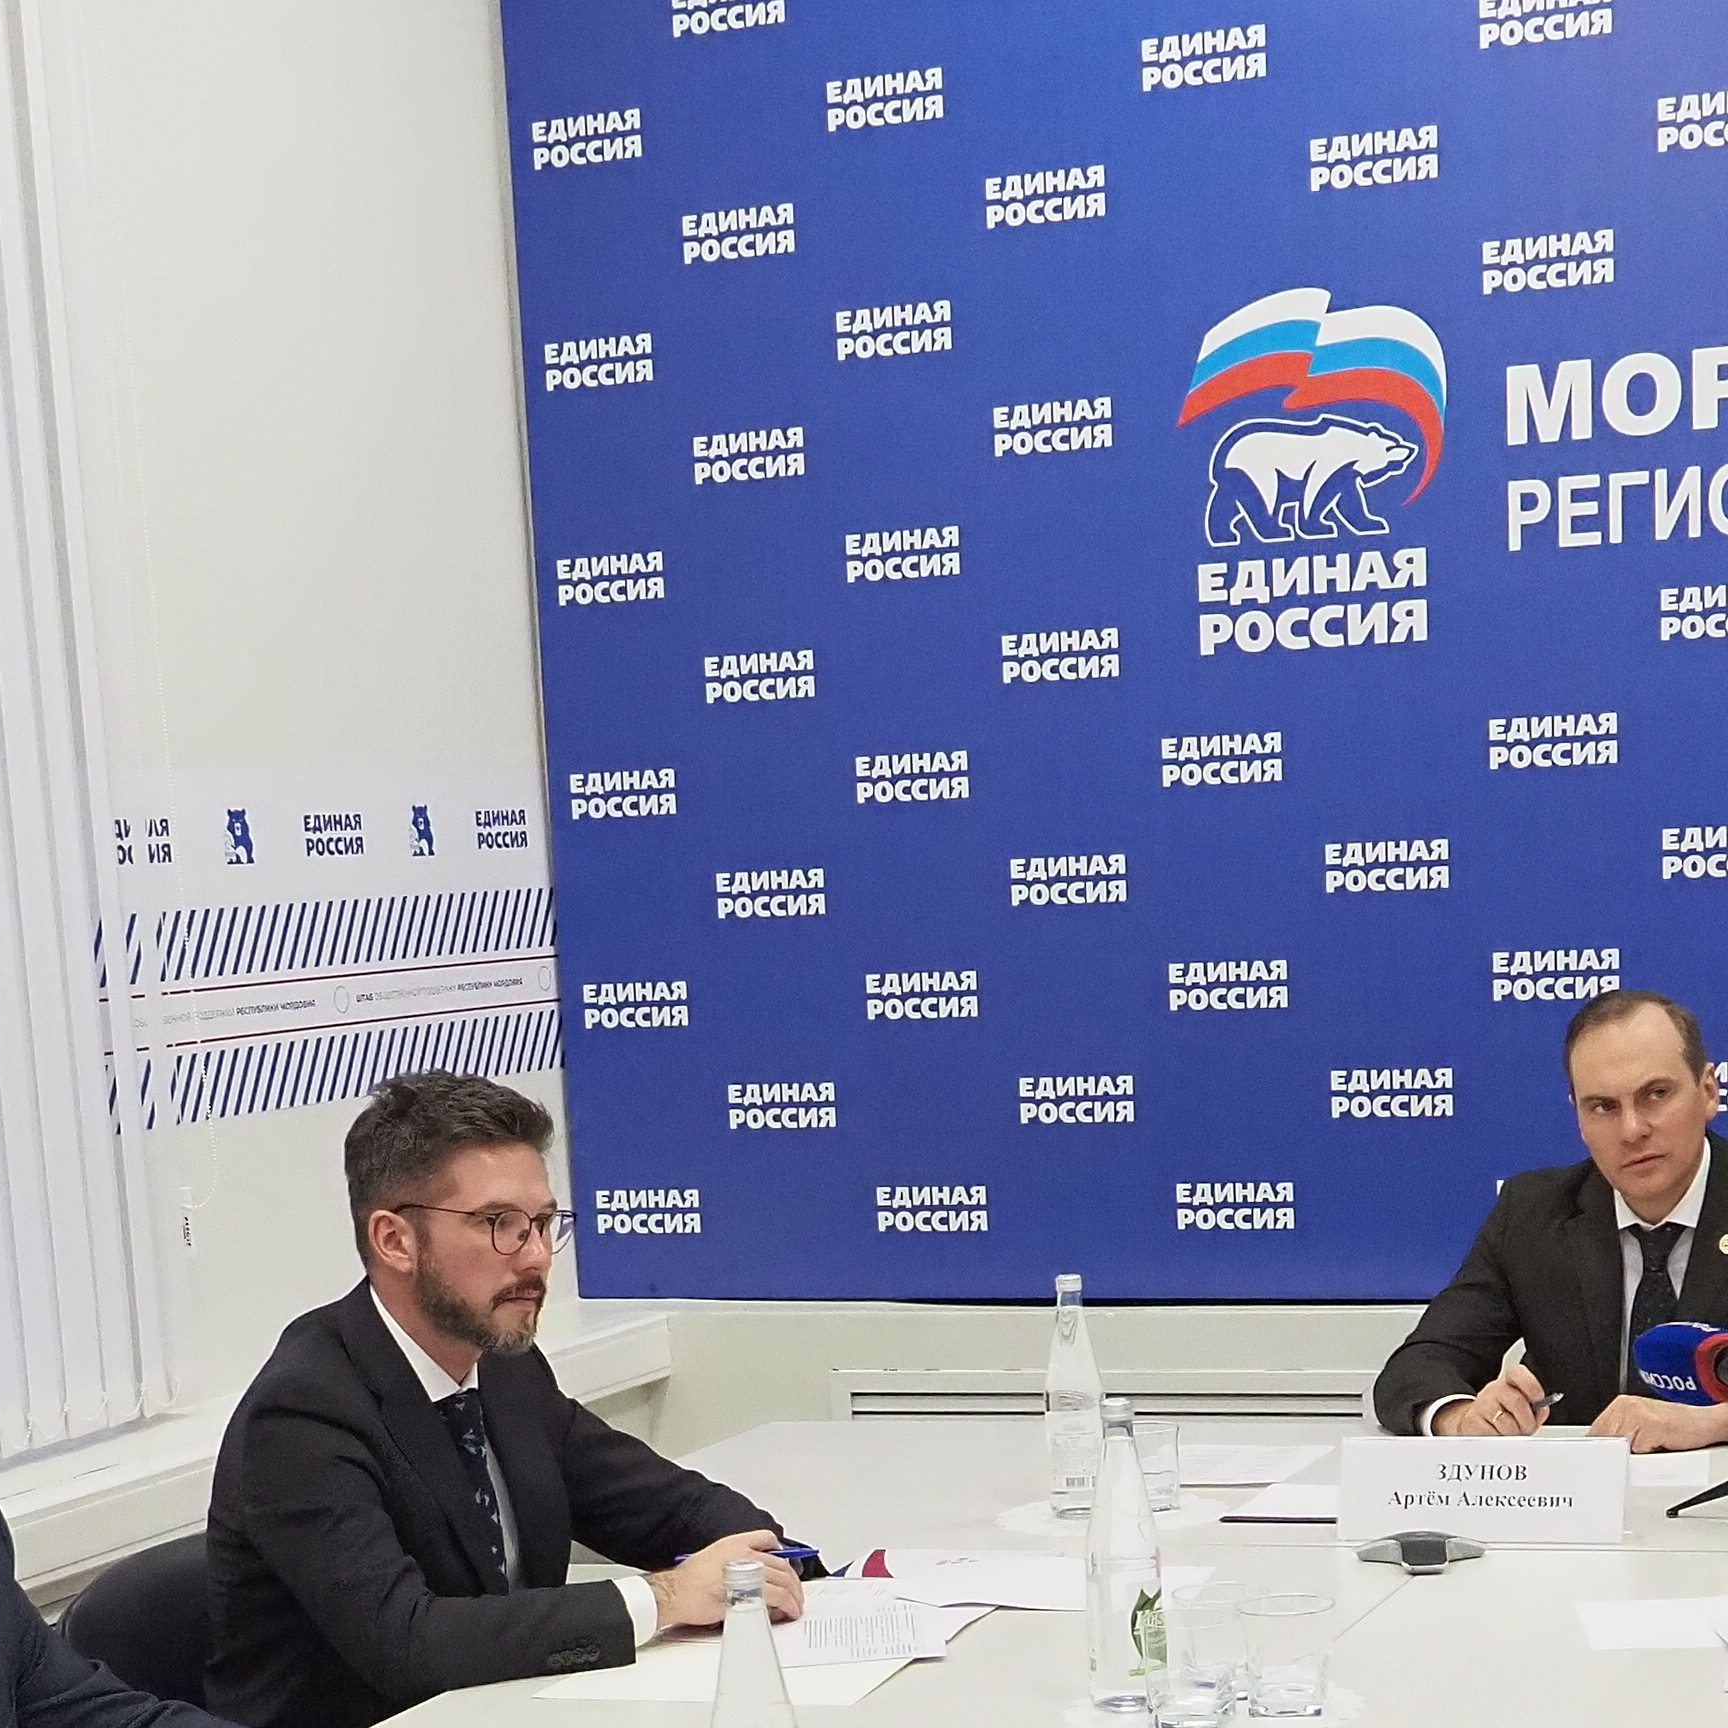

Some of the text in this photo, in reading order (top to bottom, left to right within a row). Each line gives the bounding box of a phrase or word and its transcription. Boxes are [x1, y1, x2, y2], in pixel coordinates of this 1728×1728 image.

[673, 0, 785, 38] РОССИЯ
[1479, 8, 1612, 49] РОССИЯ
[1141, 24, 1266, 63] ЕДИНАЯ
[826, 67, 942, 104] ЕДИНАЯ
[1142, 52, 1266, 92] РОССИЯ
[532, 108, 640, 143] ЕДИНАЯ
[828, 95, 943, 132] РОССИЯ
[534, 135, 642, 170] РОССИЯ
[1310, 125, 1437, 163] ЕДИНАЯ
[986, 165, 1105, 201] ЕДИНАЯ
[1310, 154, 1438, 191] РОССИЯ
[682, 203, 794, 237] ЕДИНАЯ
[986, 192, 1105, 229] РОССИЯ
[683, 229, 795, 264] РОССИЯ
[1482, 229, 1614, 266] ЕДИНАЯ
[1483, 258, 1614, 295] РОССИЯ
[836, 300, 951, 334] ЕДИНАЯ
[544, 333, 651, 365] ЕДИНАЯ
[837, 327, 952, 361] РОССИЯ
[546, 359, 653, 391] РОССИЯ
[993, 397, 1111, 430] ЕДИНАЯ
[693, 427, 803, 459] ЕДИНАЯ
[994, 424, 1112, 457] РОССИЯ
[694, 453, 804, 484] РОССИЯ
[846, 526, 959, 557] ЕДИНАЯ
[557, 551, 663, 581] ЕДИНАЯ
[847, 552, 960, 583] РОССИЯ
[1198, 547, 1426, 605] ЕДИНАЯ
[558, 577, 664, 606] РОССИЯ
[1200, 599, 1427, 655] РОССИЯ
[1002, 628, 1118, 658] ЕДИНАЯ
[704, 650, 813, 678] ЕДИНАЯ
[1003, 654, 1119, 683] РОССИЯ
[706, 676, 815, 703] РОССИЯ
[1489, 712, 1617, 742] ЕДИНАЯ
[1161, 732, 1281, 761] ЕДИНАЯ
[1490, 740, 1617, 770] РОССИЯ
[855, 750, 968, 778] ЕДИНАЯ
[1162, 759, 1282, 787] РОССИЯ
[570, 769, 675, 795] ЕДИНАЯ
[857, 777, 969, 804] РОССИЯ
[475, 809, 526, 828] ЕДИНАЯ
[572, 793, 676, 819] РОССИЯ
[304, 814, 362, 834] ЕДИНАЯ
[306, 836, 364, 856] РОССИЯ
[477, 830, 528, 849] РОССИЯ
[1325, 839, 1448, 867] ЕДИНАЯ
[716, 868, 824, 894] ЕДИНАЯ
[1010, 854, 1125, 881] ЕДИНАЯ
[1326, 866, 1449, 893] РОССИЯ
[718, 894, 825, 919] РОССИЯ
[1011, 880, 1126, 906] РОССИЯ
[1169, 960, 1287, 986] ЕДИНАЯ
[1493, 948, 1619, 975] ЕДИНАЯ
[583, 981, 687, 1005] ЕДИНАЯ
[866, 971, 977, 996] ЕДИНАЯ
[867, 996, 978, 1020] РОССИЯ
[1169, 986, 1288, 1011] РОССИЯ
[585, 1006, 688, 1029] РОССИЯ
[728, 1083, 835, 1106] ЕДИНАЯ
[1019, 1075, 1133, 1099] ЕДИНАЯ
[1331, 1068, 1452, 1093] ЕДИНАЯ
[729, 1107, 836, 1129] РОССИЯ
[1020, 1101, 1134, 1124] РОССИЯ
[1331, 1095, 1453, 1118] РОССИЯ
[596, 1189, 699, 1211] ЕДИНАЯ
[877, 1186, 986, 1208] ЕДИНАЯ
[1176, 1182, 1293, 1205] ЕДИНАЯ
[597, 1213, 701, 1234] РОССИЯ
[878, 1211, 988, 1231] РОССИЯ
[1177, 1208, 1294, 1229] РОССИЯ
[1437, 1464, 1527, 1482] ЗДУНОВ
[1389, 1491, 1573, 1509] Артём Алексеевич
